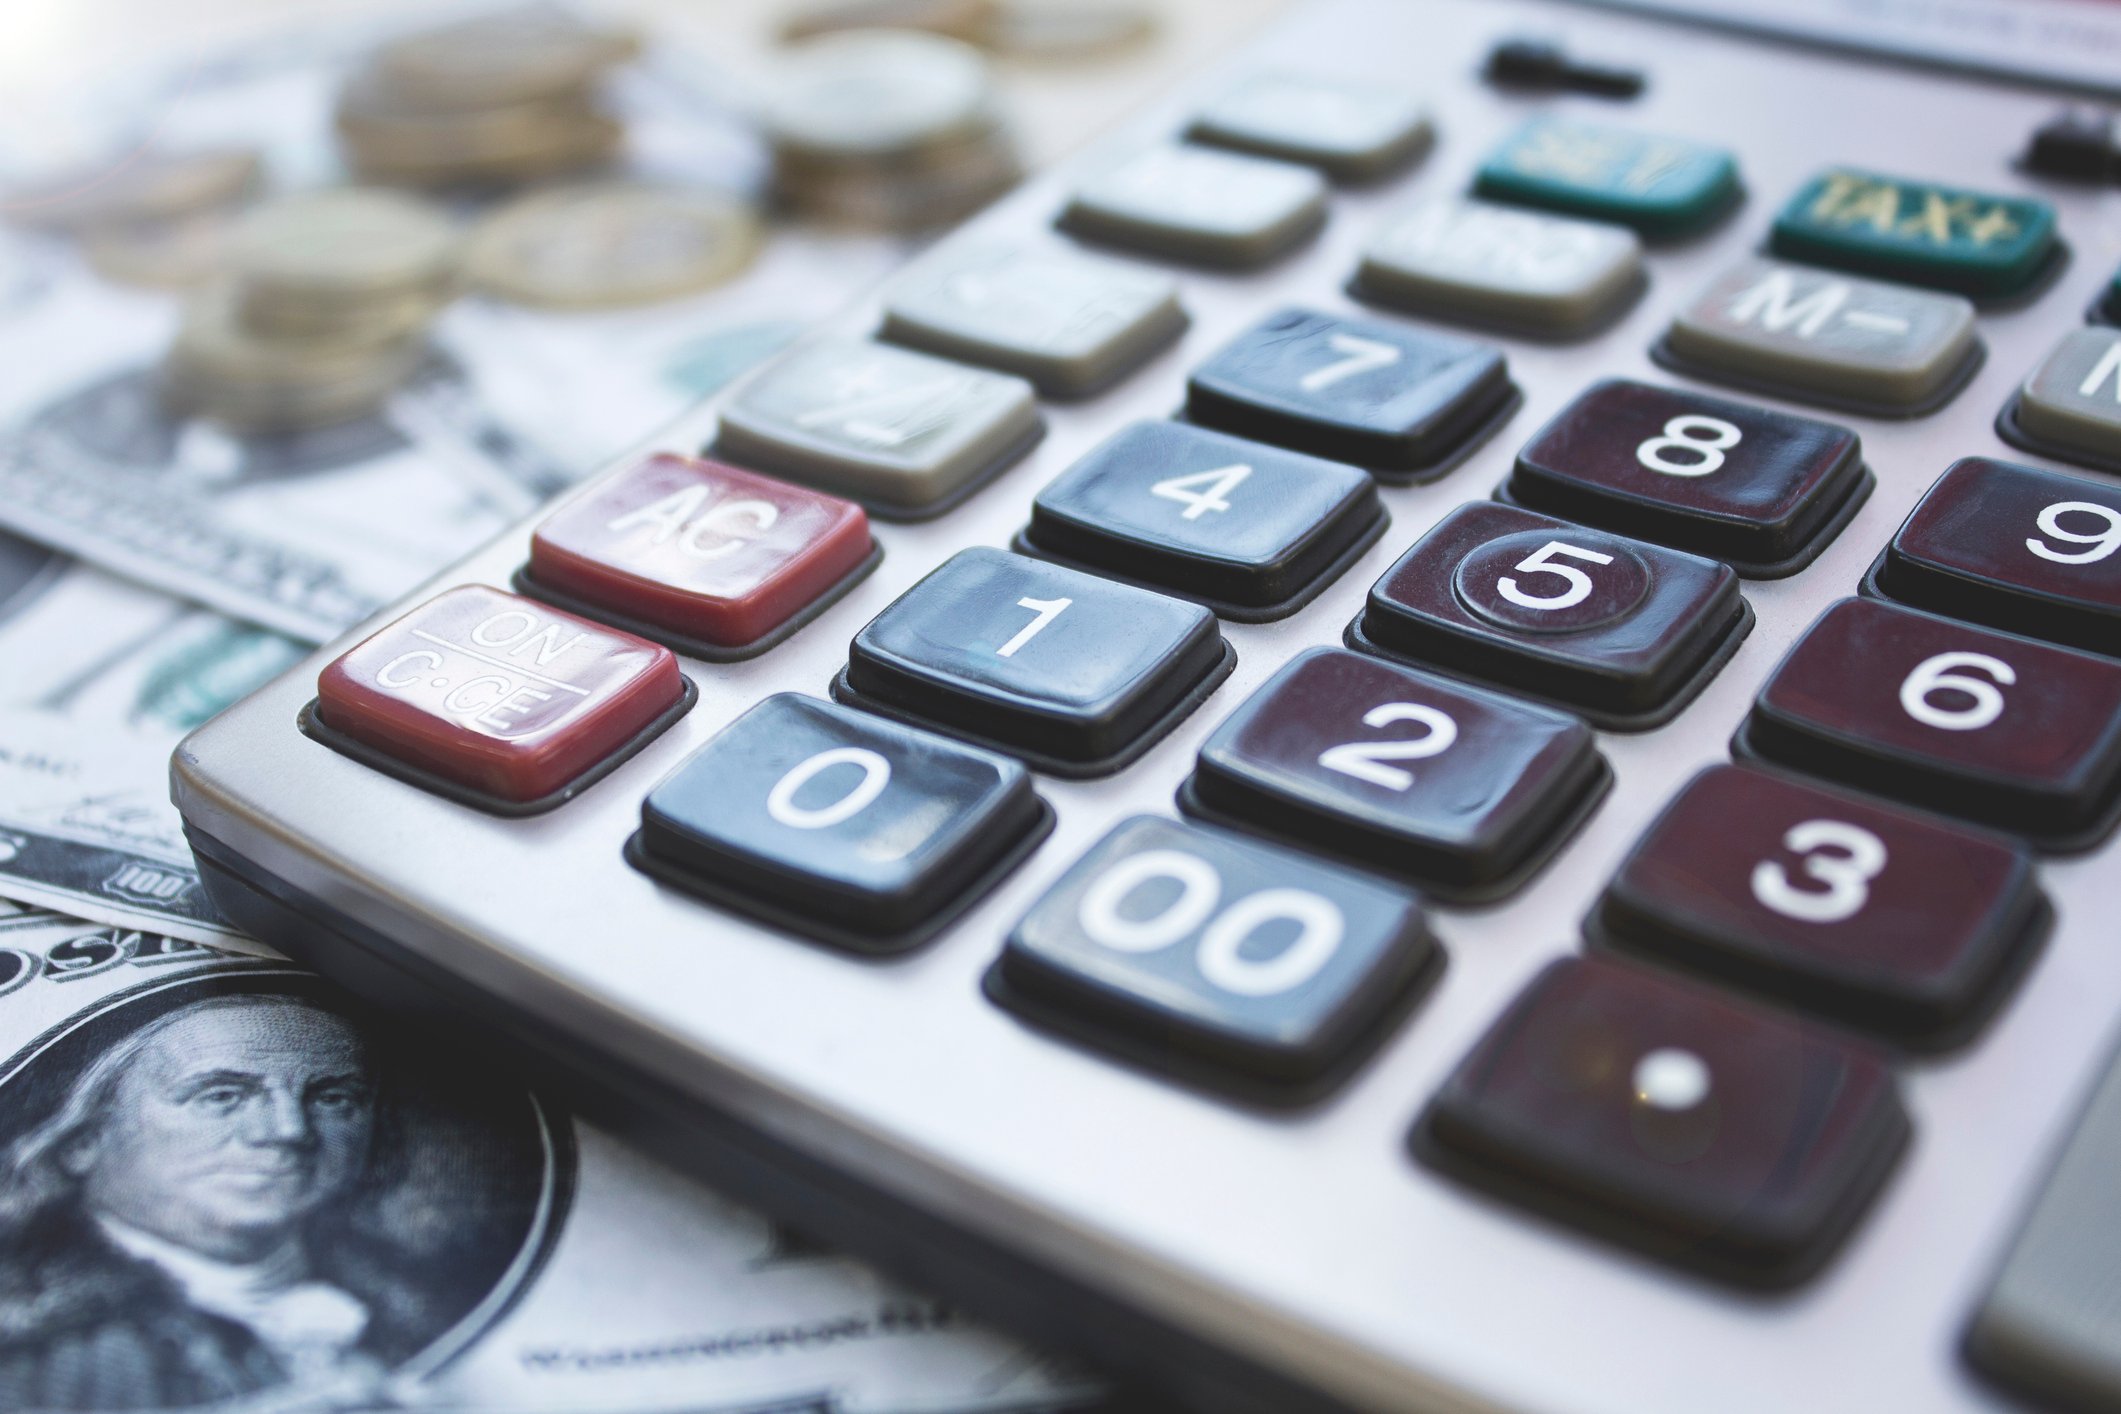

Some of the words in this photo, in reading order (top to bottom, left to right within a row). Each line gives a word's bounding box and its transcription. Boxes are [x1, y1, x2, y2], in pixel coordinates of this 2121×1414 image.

[1298, 334, 1401, 392] 7
[1636, 415, 1742, 477] 8
[607, 483, 779, 559] AC
[1150, 463, 1251, 521] 4
[2025, 501, 2121, 565] 9
[1497, 541, 1614, 611] 5
[470, 607, 589, 667] ON
[995, 596, 1073, 658] 1
[1900, 651, 2017, 731] 6
[1317, 702, 1458, 793] 2
[766, 747, 892, 830] 0
[116, 865, 186, 899] 100
[1750, 818, 1889, 924] 3
[1078, 848, 1346, 997] 00
